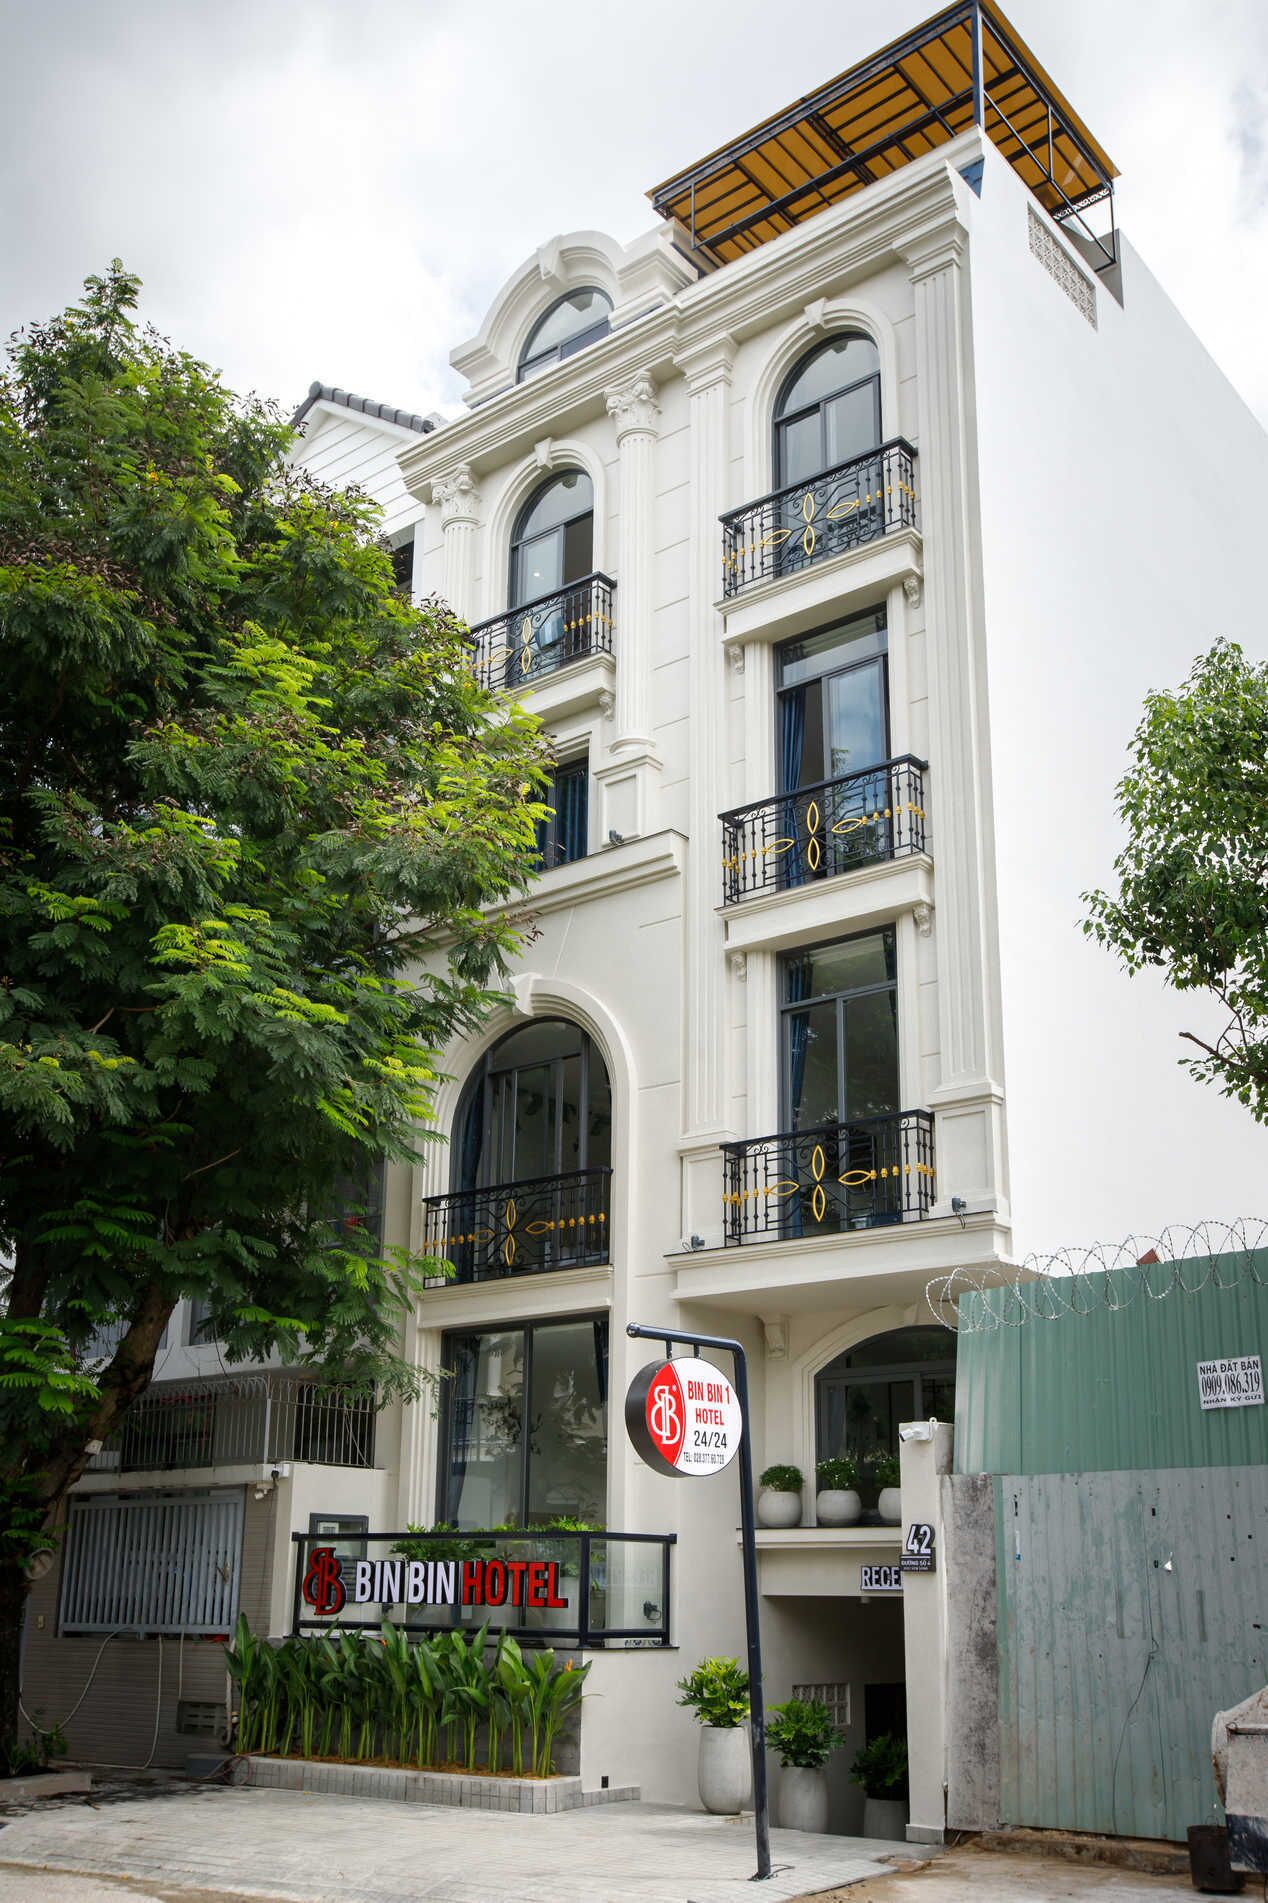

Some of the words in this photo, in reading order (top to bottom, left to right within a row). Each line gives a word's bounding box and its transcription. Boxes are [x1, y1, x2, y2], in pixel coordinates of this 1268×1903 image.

[687, 1380, 704, 1401] BIN
[707, 1383, 723, 1404] BIN
[725, 1385, 730, 1405] 1
[1201, 1370, 1260, 1397] 0909.086.319
[695, 1407, 725, 1426] HOTEL
[694, 1430, 728, 1449] 24/24
[906, 1524, 932, 1555] 42
[355, 1561, 400, 1604] BIN
[406, 1561, 455, 1605] BIN
[459, 1559, 568, 1608] HOTEL
